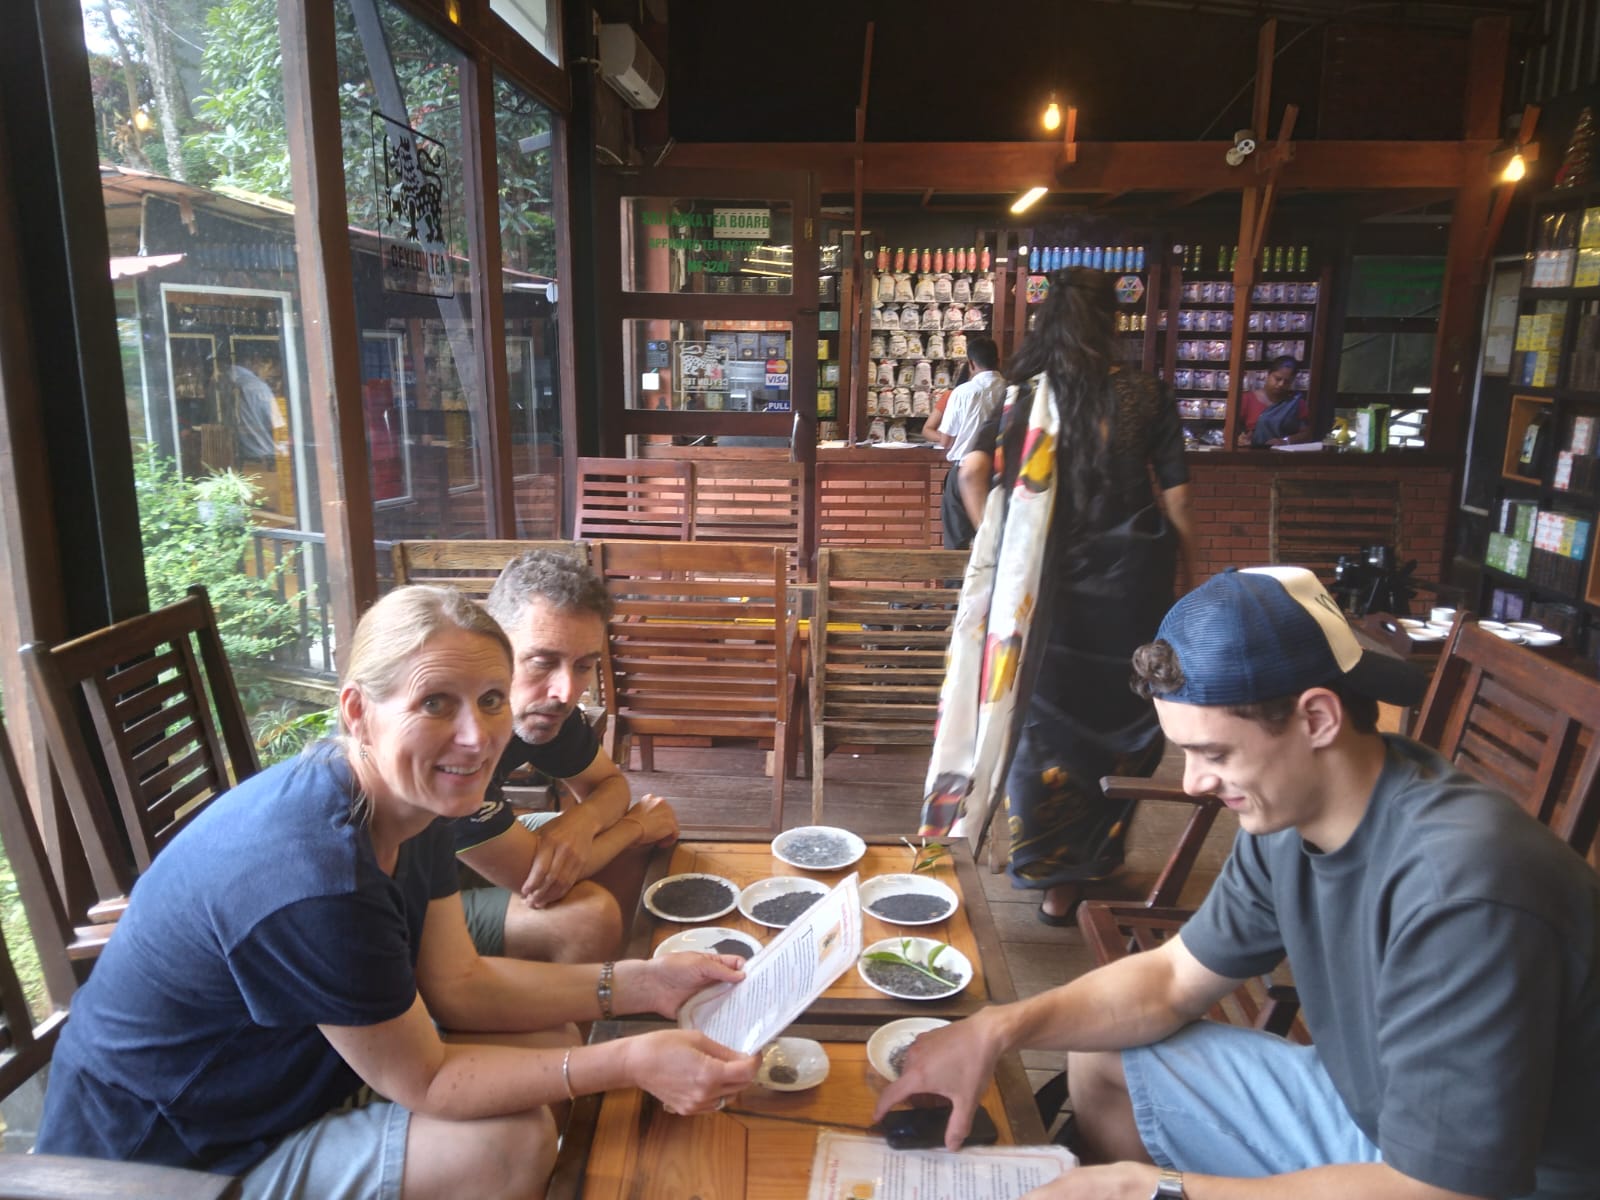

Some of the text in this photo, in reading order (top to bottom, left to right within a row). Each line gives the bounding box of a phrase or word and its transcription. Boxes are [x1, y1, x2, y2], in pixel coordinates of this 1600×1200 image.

[706, 213, 727, 228] TEA
[730, 214, 770, 229] BOARD
[702, 239, 719, 251] TEA
[391, 244, 446, 276] CEYLON TEA
[767, 375, 788, 384] VISA
[768, 402, 789, 410] PULL
